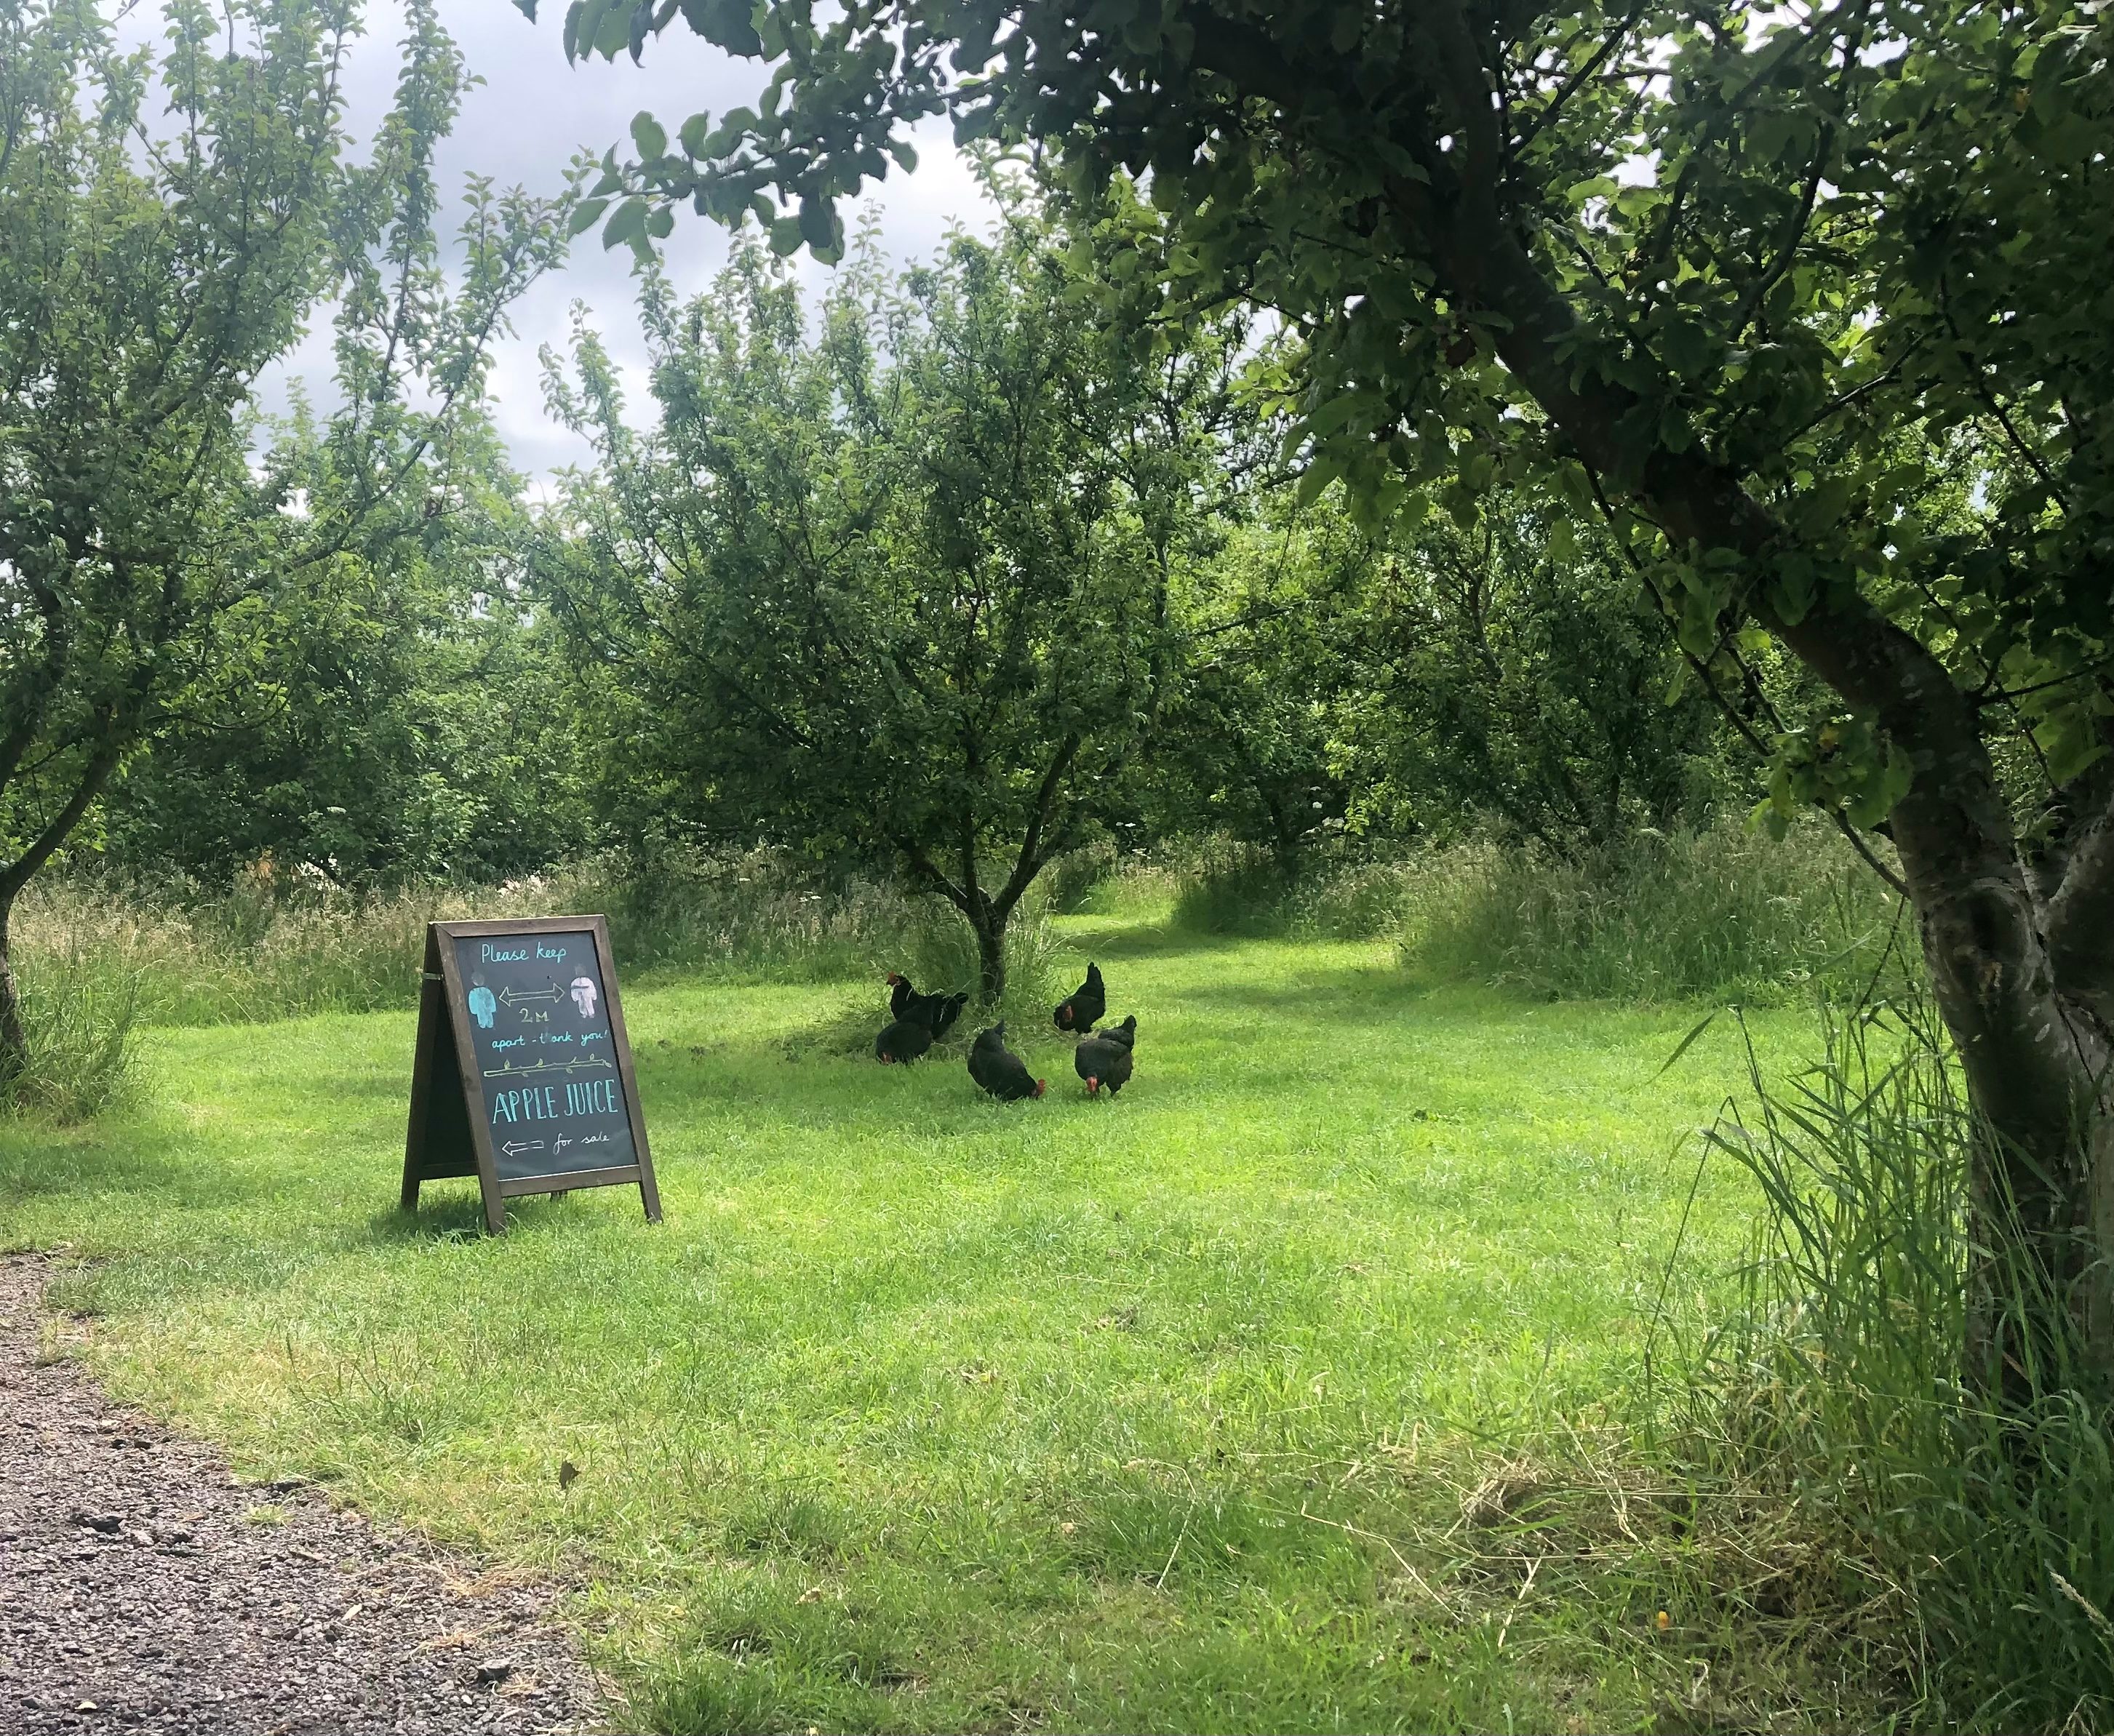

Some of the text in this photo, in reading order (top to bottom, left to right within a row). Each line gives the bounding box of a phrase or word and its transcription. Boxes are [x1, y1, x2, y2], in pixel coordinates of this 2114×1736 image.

[482, 941, 567, 963] Please keep
[492, 1034, 525, 1052] apart
[581, 1029, 608, 1047] you!
[492, 1079, 618, 1124] APPLE JUICE
[553, 1131, 610, 1156] for sale
